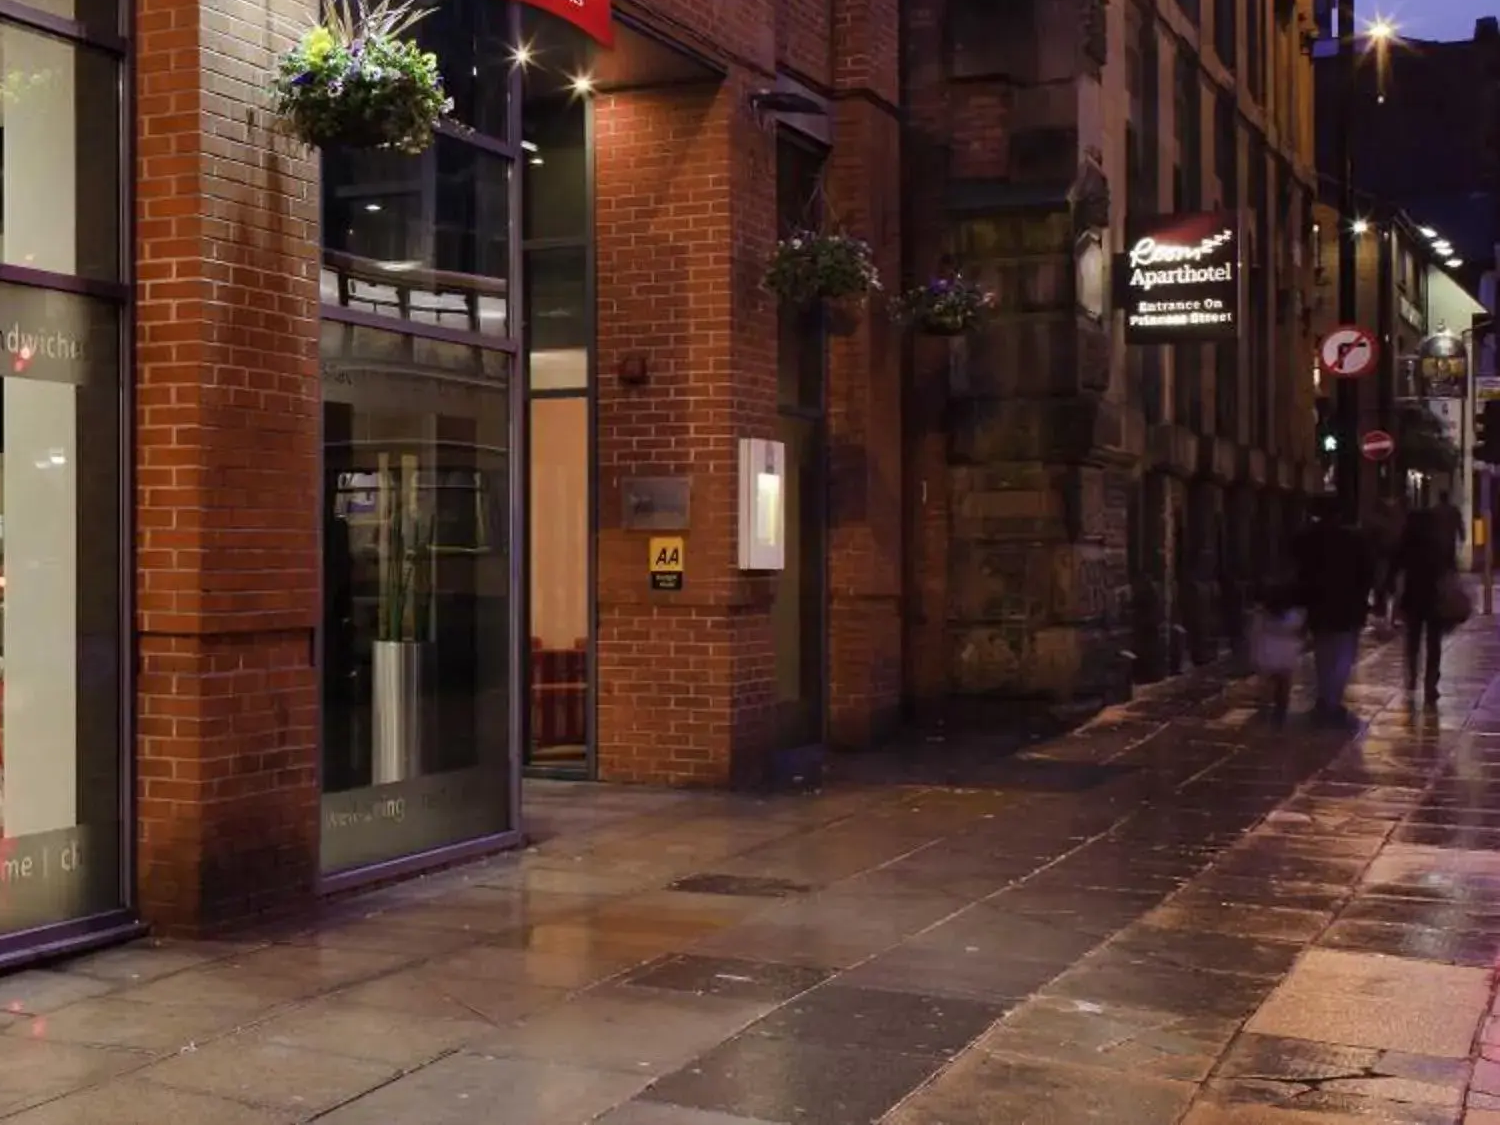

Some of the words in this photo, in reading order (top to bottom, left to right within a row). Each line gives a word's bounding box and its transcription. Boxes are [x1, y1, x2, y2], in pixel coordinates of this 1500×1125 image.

[1130, 262, 1231, 290] Aparthotel
[1139, 301, 1200, 312] Entrance
[1203, 298, 1223, 308] On
[1190, 312, 1232, 324] Street
[656, 547, 679, 565] AA
